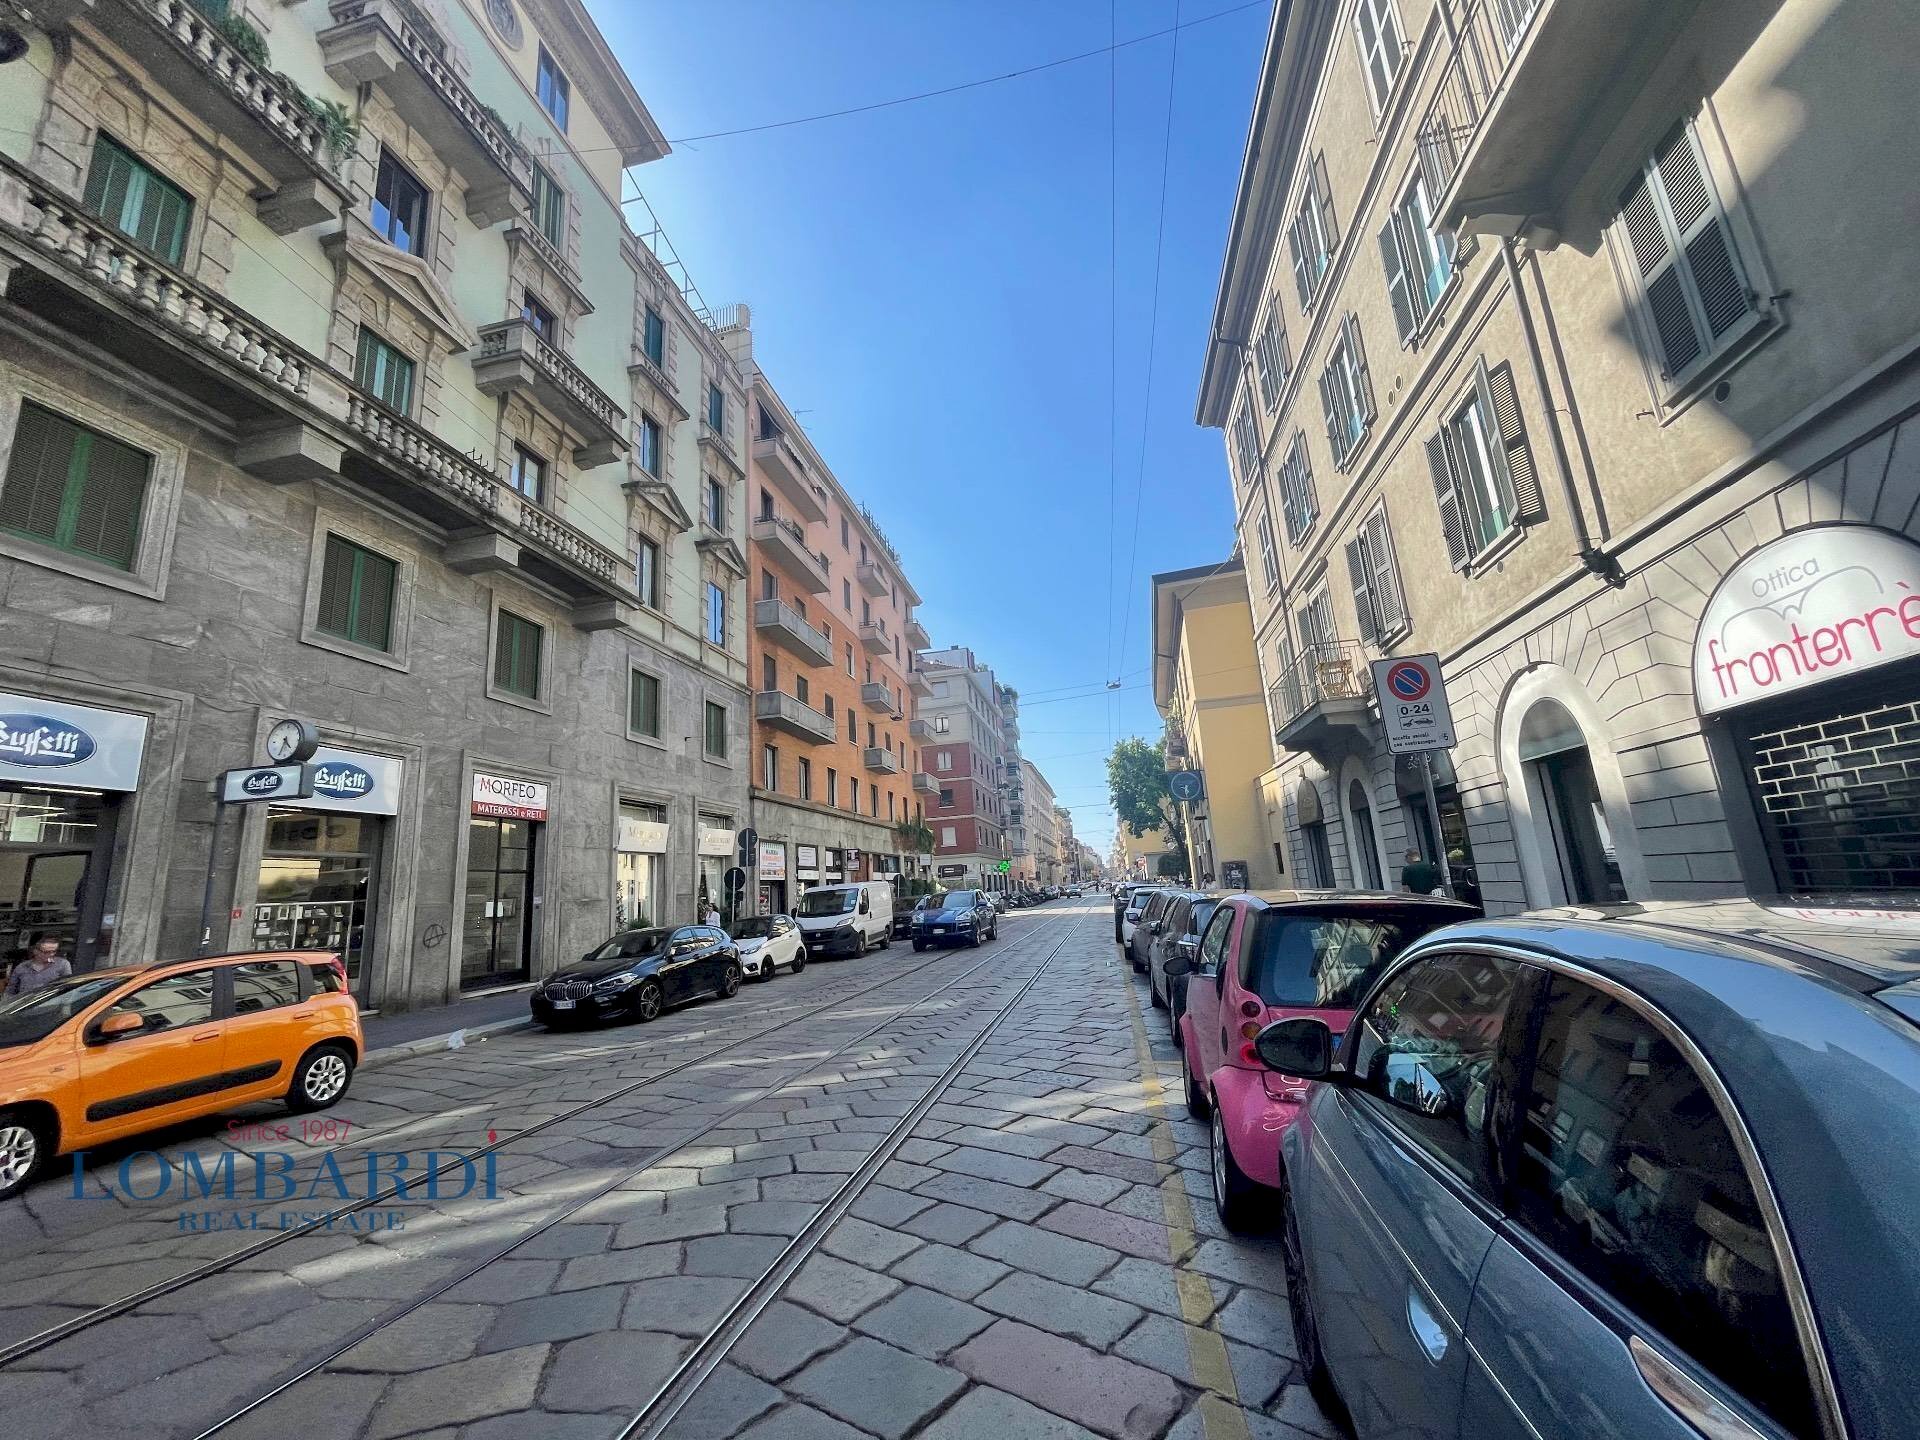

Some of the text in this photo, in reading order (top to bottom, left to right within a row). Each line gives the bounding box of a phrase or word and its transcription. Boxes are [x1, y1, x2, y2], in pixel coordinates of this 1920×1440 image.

[1752, 558, 1820, 597] Ottica
[1401, 704, 1430, 715] 0-24
[247, 775, 278, 790] Buffetti
[313, 767, 366, 792] Buffetti
[479, 777, 536, 798] MORFEO
[477, 804, 519, 816] MATERASSI
[526, 810, 542, 819] RETI
